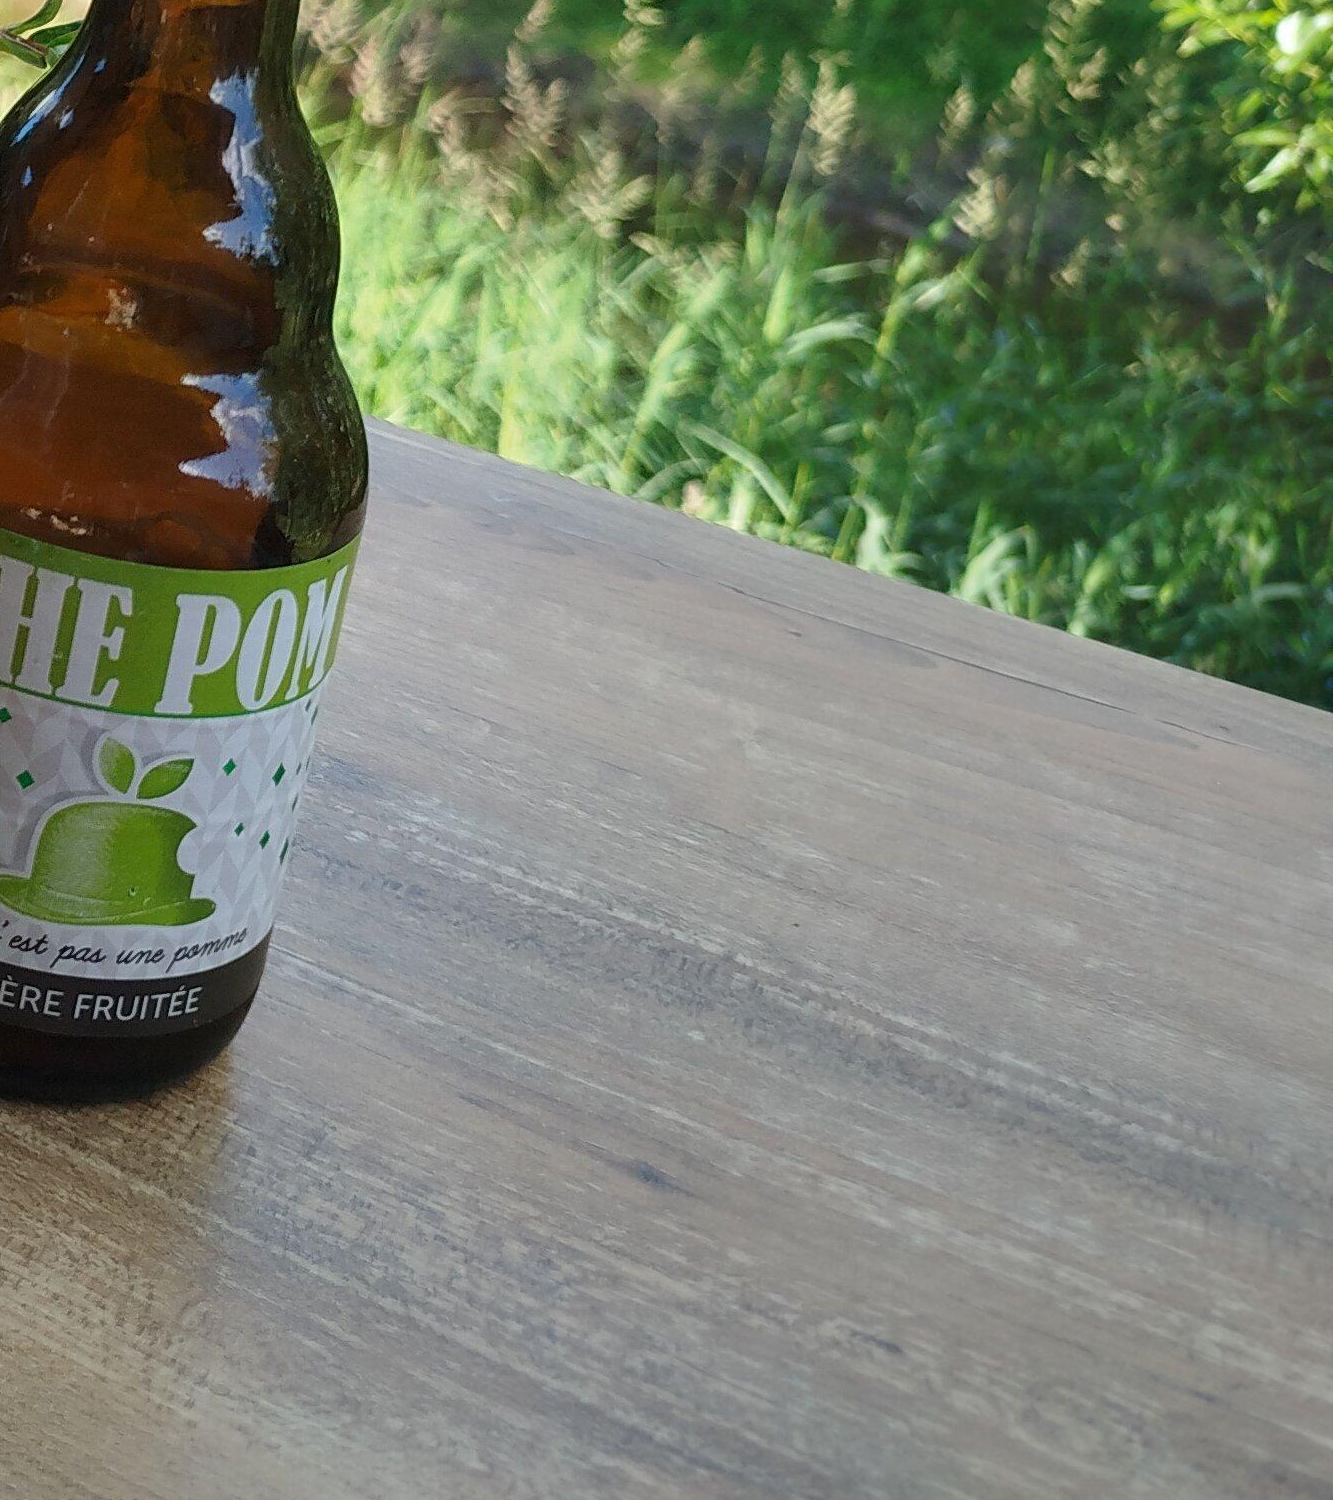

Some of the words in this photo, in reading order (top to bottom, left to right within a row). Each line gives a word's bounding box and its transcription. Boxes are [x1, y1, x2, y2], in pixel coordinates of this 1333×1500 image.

[155, 564, 348, 715] POM
[49, 943, 107, 968] pas
[116, 945, 165, 965] une
[165, 927, 248, 973] pomme
[73, 985, 204, 1021] FRUITÉE
